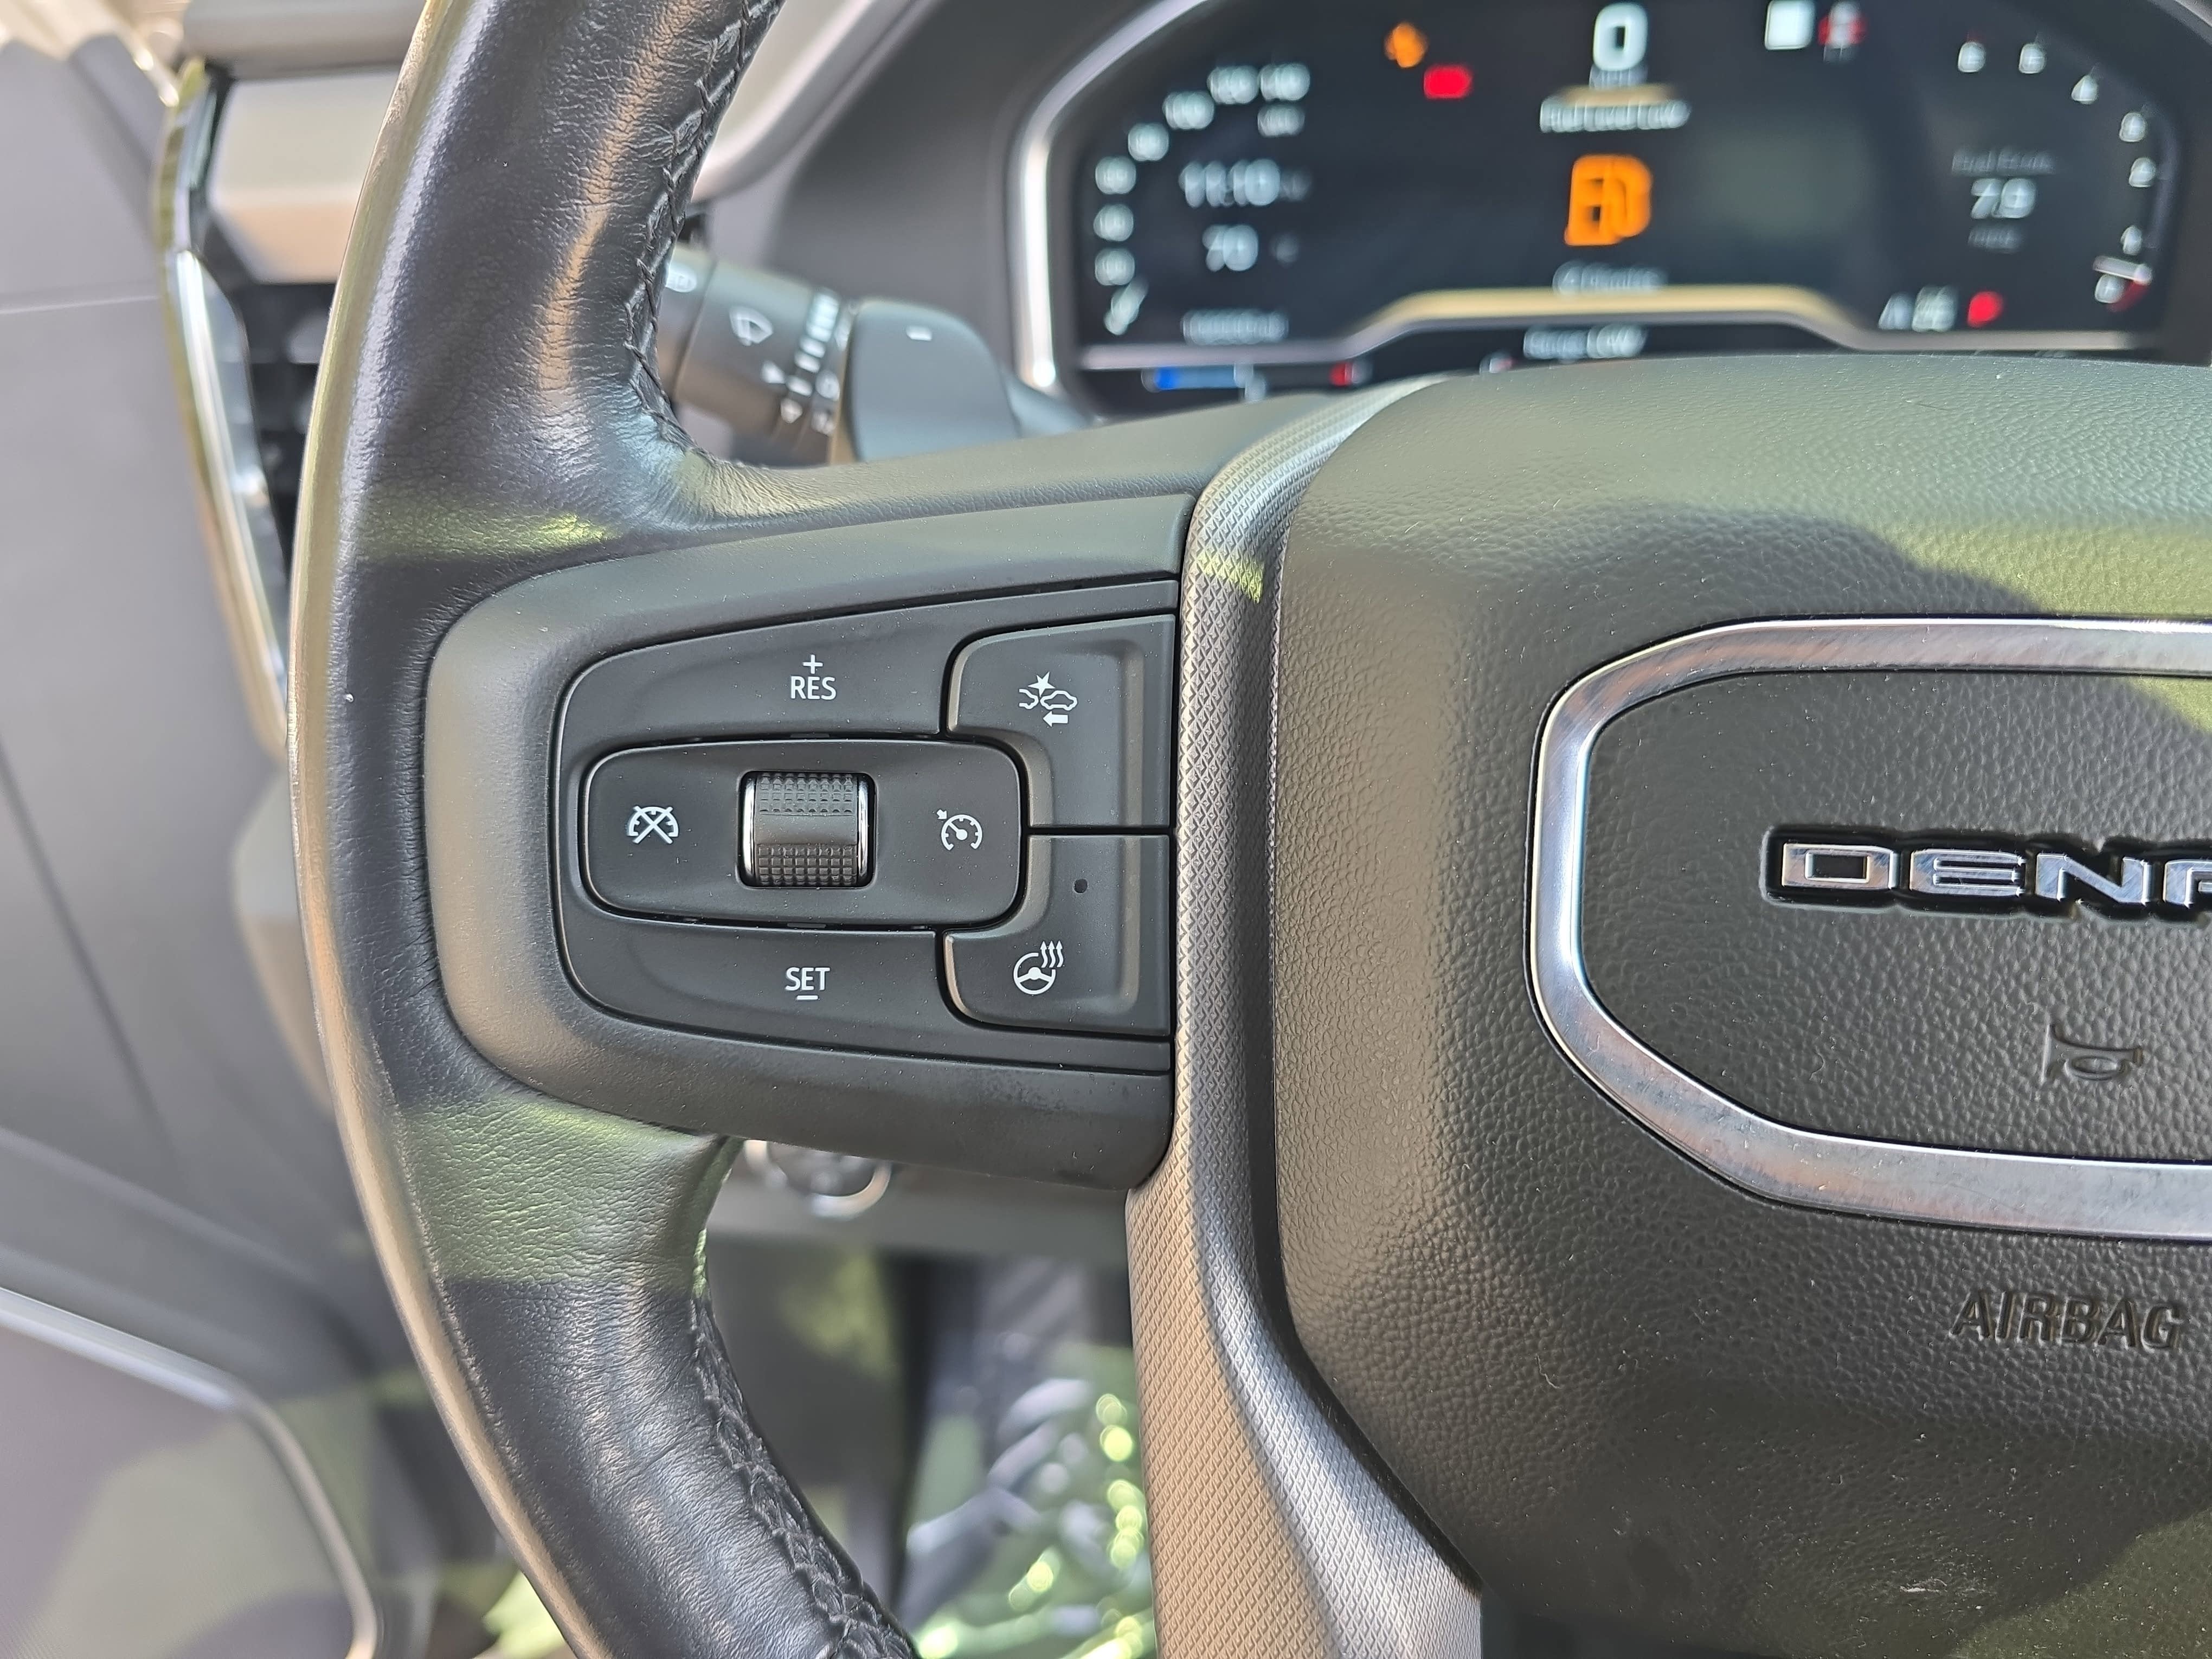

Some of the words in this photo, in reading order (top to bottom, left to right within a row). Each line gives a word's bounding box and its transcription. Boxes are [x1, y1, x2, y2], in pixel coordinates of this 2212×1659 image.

[1592, 2, 1648, 72] 0
[790, 676, 837, 700] RES
[785, 967, 831, 991] SET
[1949, 1290, 2185, 1353] AIRBAG
